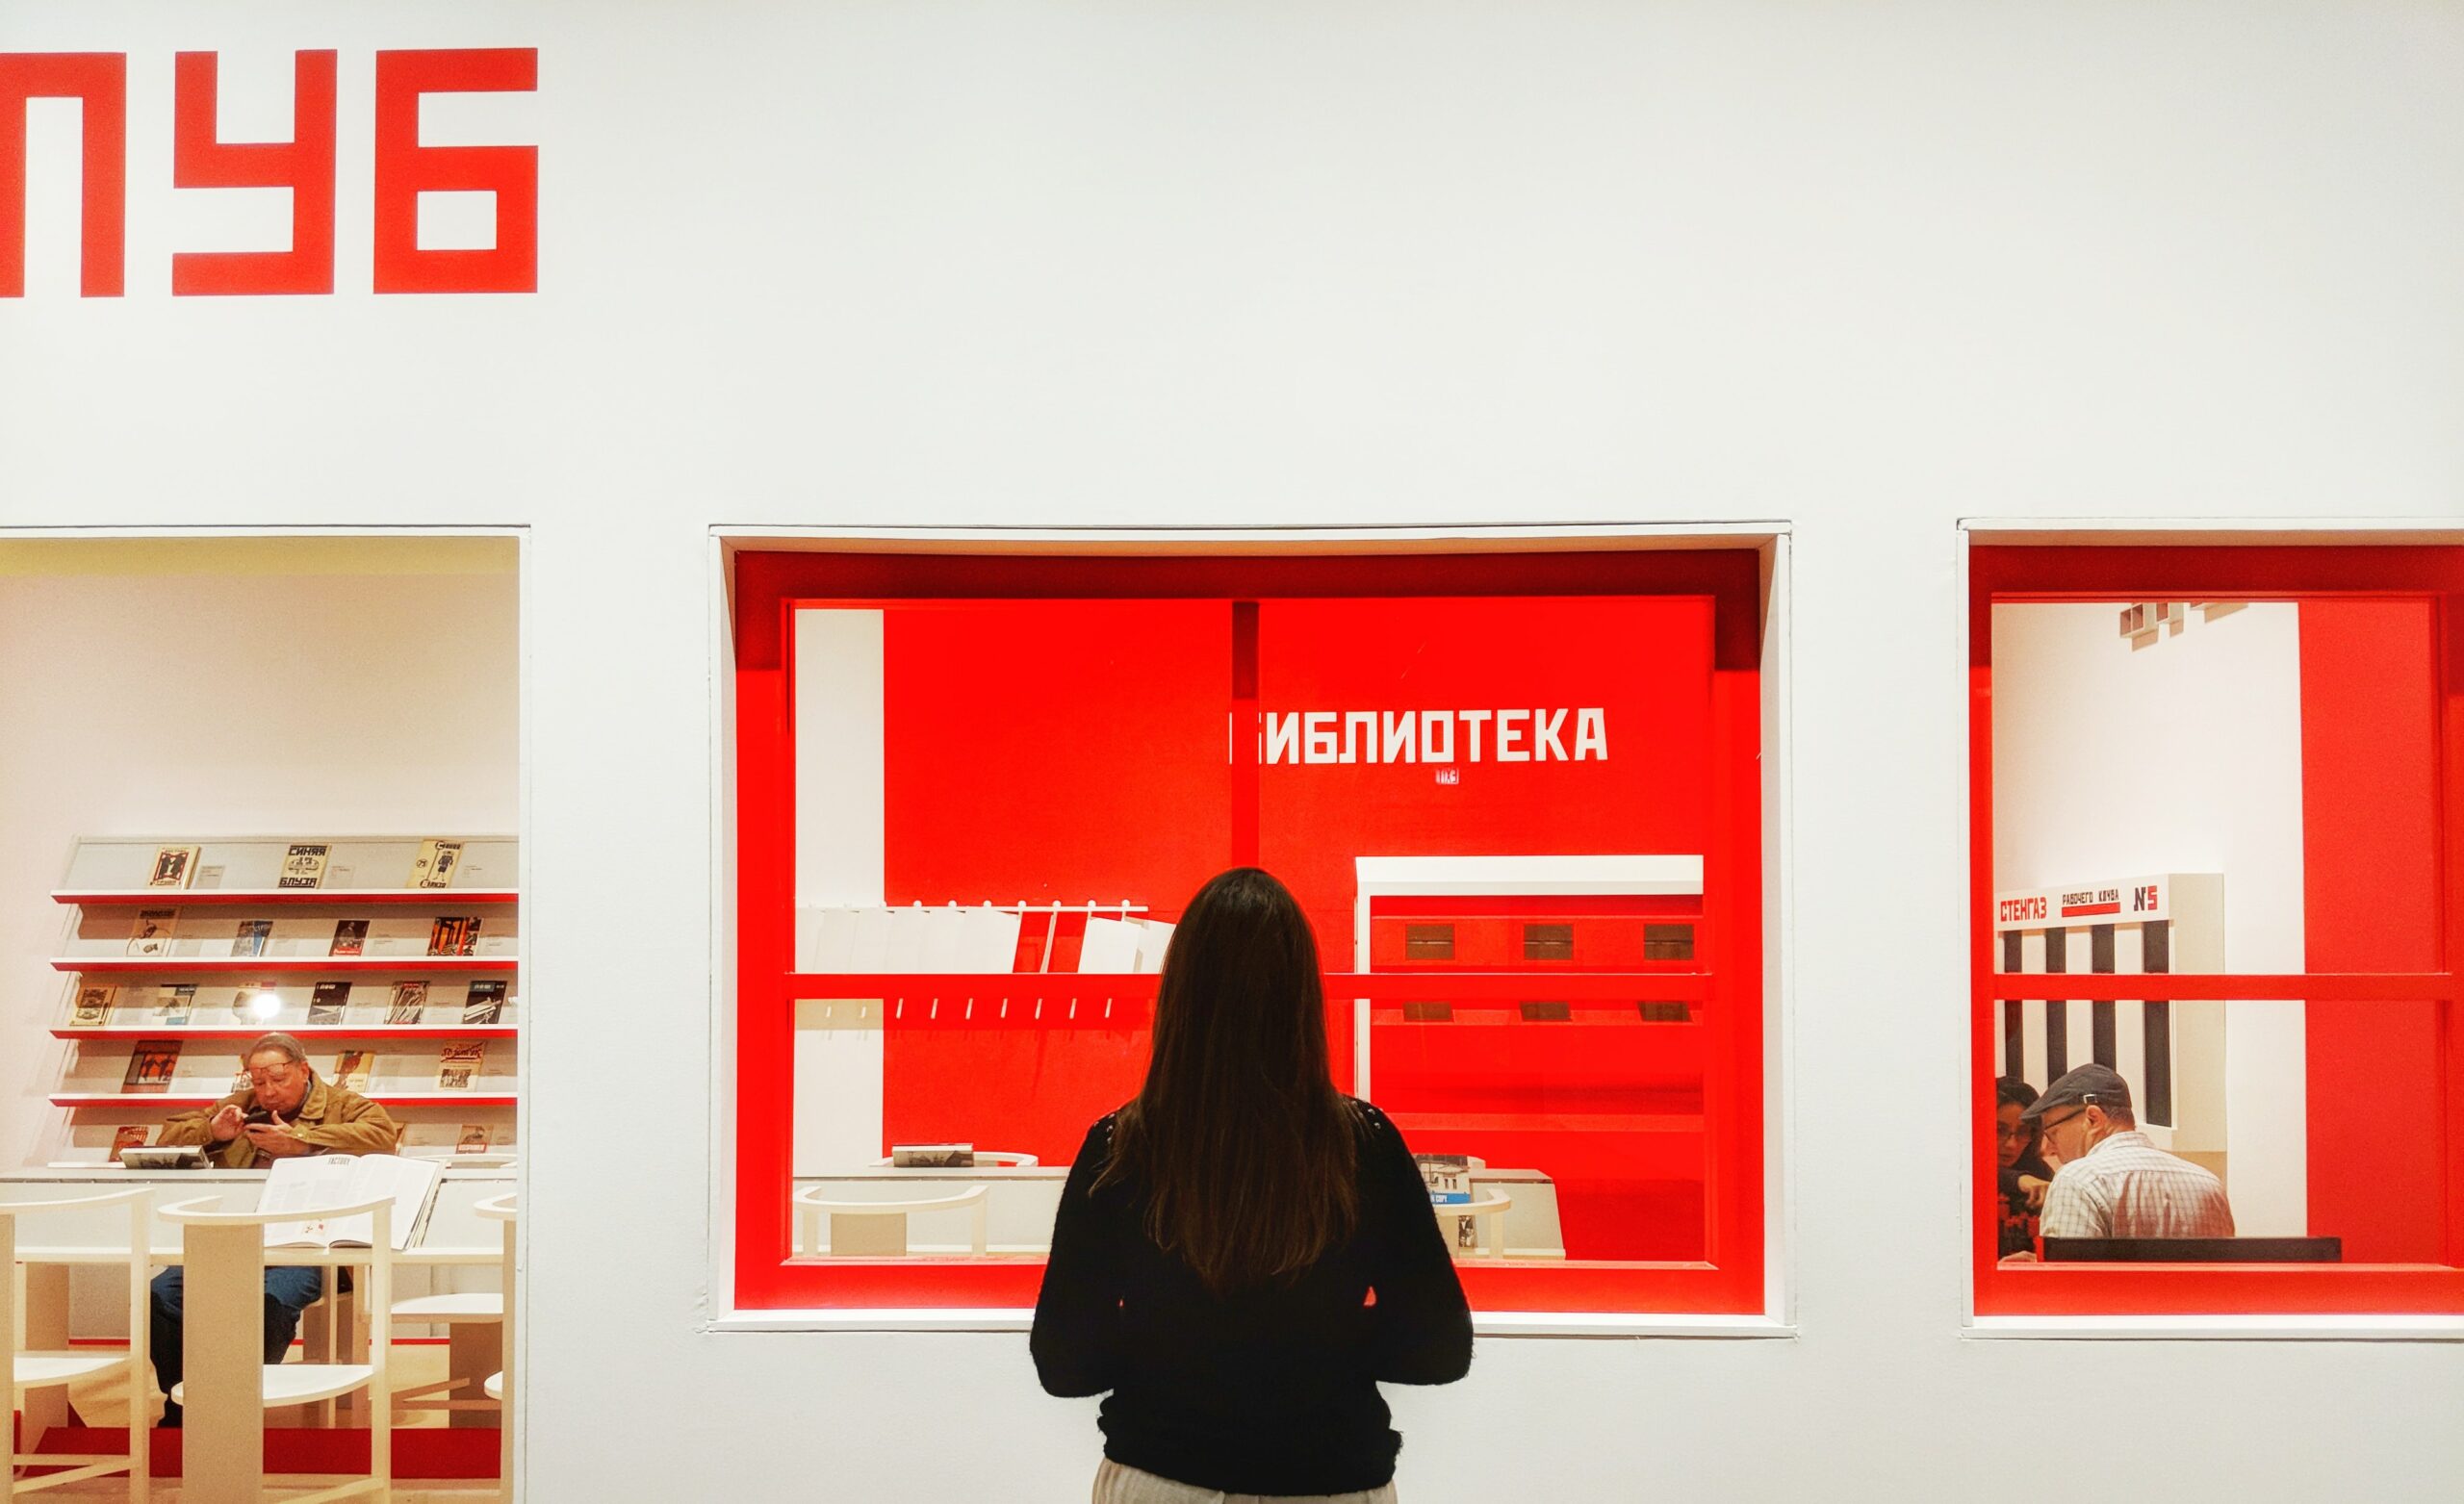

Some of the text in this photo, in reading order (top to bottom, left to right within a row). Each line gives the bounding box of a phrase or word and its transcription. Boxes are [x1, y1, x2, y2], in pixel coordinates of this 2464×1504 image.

[1229, 707, 1608, 764] ИБЛИОТЕКА
[288, 847, 326, 856] СИНЯЯ
[279, 877, 318, 886] БЛУЗА
[2000, 897, 2047, 922] СТЕНГАЗ
[2062, 891, 2093, 905] РАБОЧЕГО
[2098, 888, 2119, 902] КЛУБА
